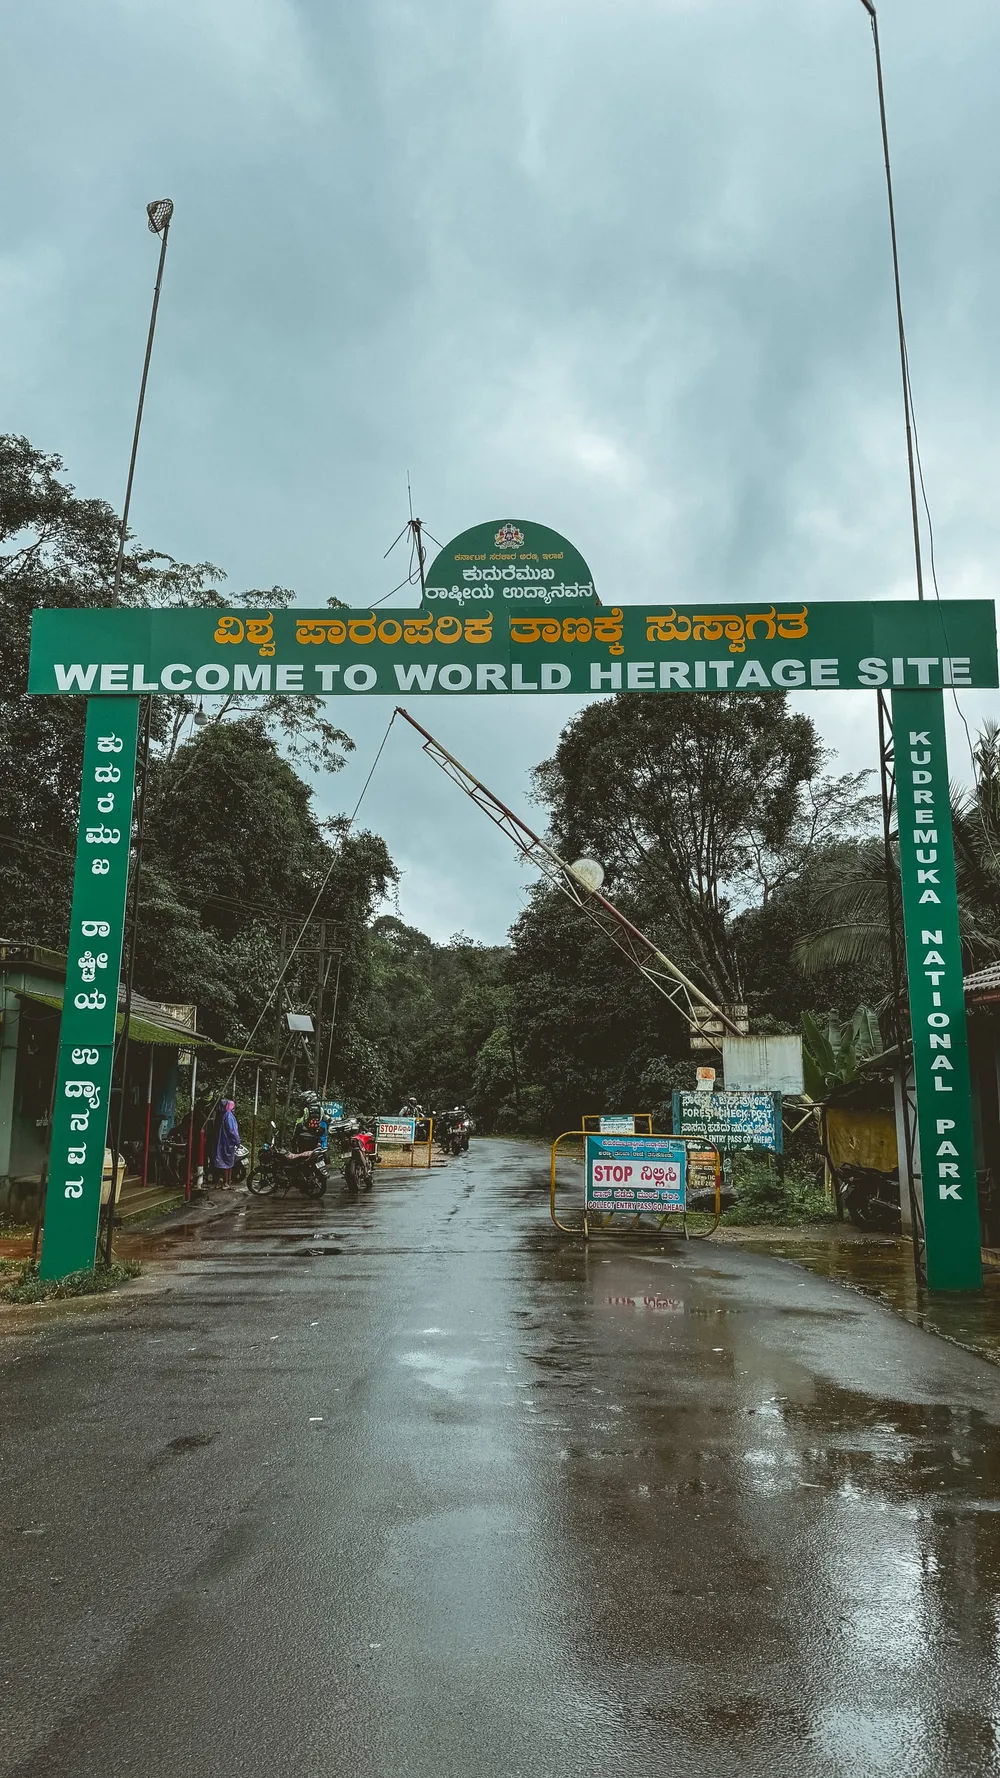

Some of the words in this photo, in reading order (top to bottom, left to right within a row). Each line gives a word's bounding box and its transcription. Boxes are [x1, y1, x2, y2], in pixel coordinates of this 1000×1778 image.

[462, 564, 555, 581] ಕುದುರೆಮುಖ
[502, 581, 594, 604] ಉದ್ಯಾನವನ
[214, 611, 276, 656] ವಿಶ್ವ
[296, 611, 494, 644] ಪಾರಂಪರಿಕ
[510, 607, 625, 655] ತಾಣಕ್ಕೆ
[646, 605, 809, 653] ಸುಸ್ವಾಗತ
[53, 664, 304, 691] WELCOME
[315, 664, 378, 690] TO
[394, 662, 572, 691] WORLD
[589, 658, 839, 689] HERITAGE
[857, 657, 972, 685] SITE
[909, 731, 942, 904] KUDREMUKA
[921, 930, 954, 1091] NATIONAL
[380, 1124, 398, 1133] STOP
[936, 1119, 963, 1200] PARK
[594, 1165, 633, 1182] STOP
[641, 1166, 677, 1187] ನಿಲ್ಲಿಸಿ
[588, 1201, 615, 1209] COLLECT
[616, 1202, 636, 1210] ENTRY
[637, 1202, 653, 1211] PASS
[653, 1203, 662, 1211] GO
[662, 1203, 684, 1212] AHEAD
